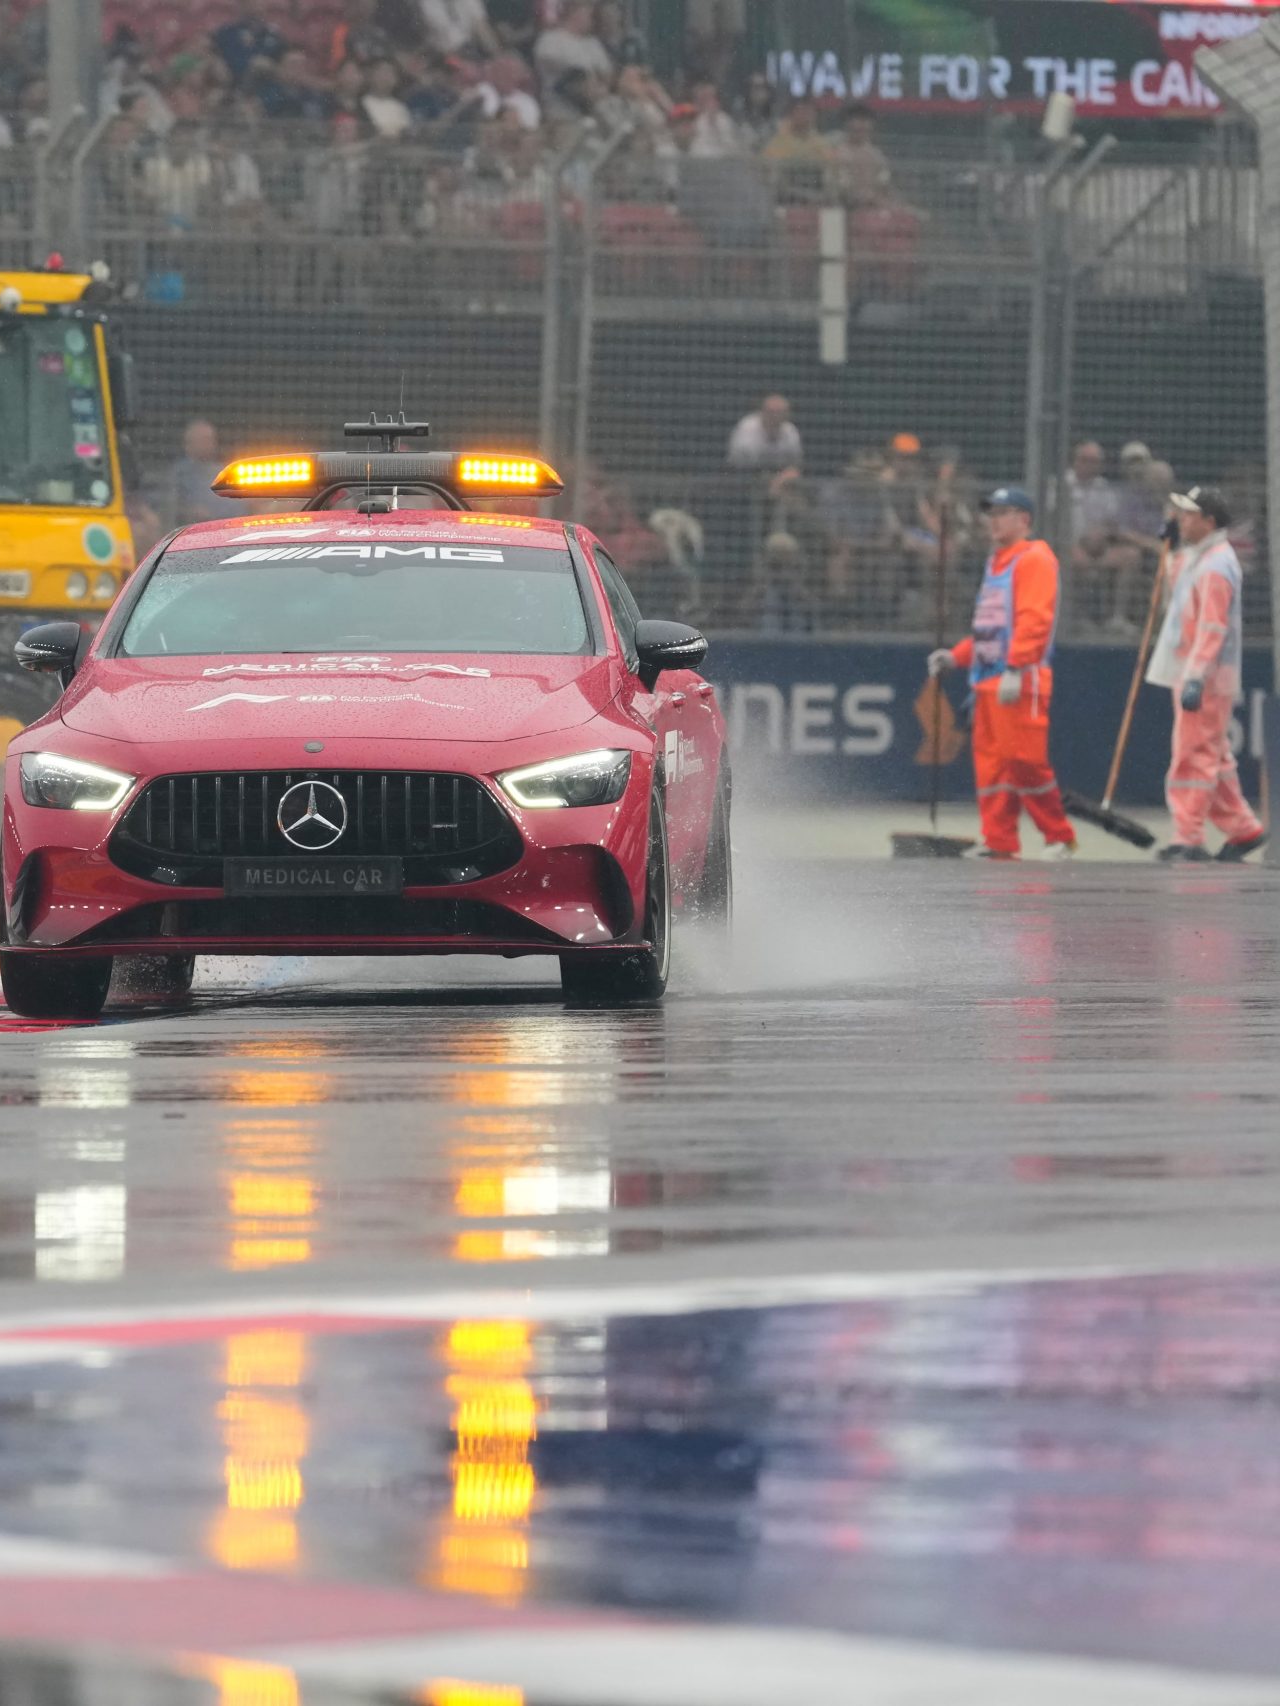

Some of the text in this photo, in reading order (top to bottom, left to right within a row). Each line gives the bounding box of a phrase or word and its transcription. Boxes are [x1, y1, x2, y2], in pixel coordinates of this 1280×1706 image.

[1024, 56, 1116, 104] THE
[309, 546, 504, 562] AMG
[245, 868, 382, 884] MEDICAL CAR
